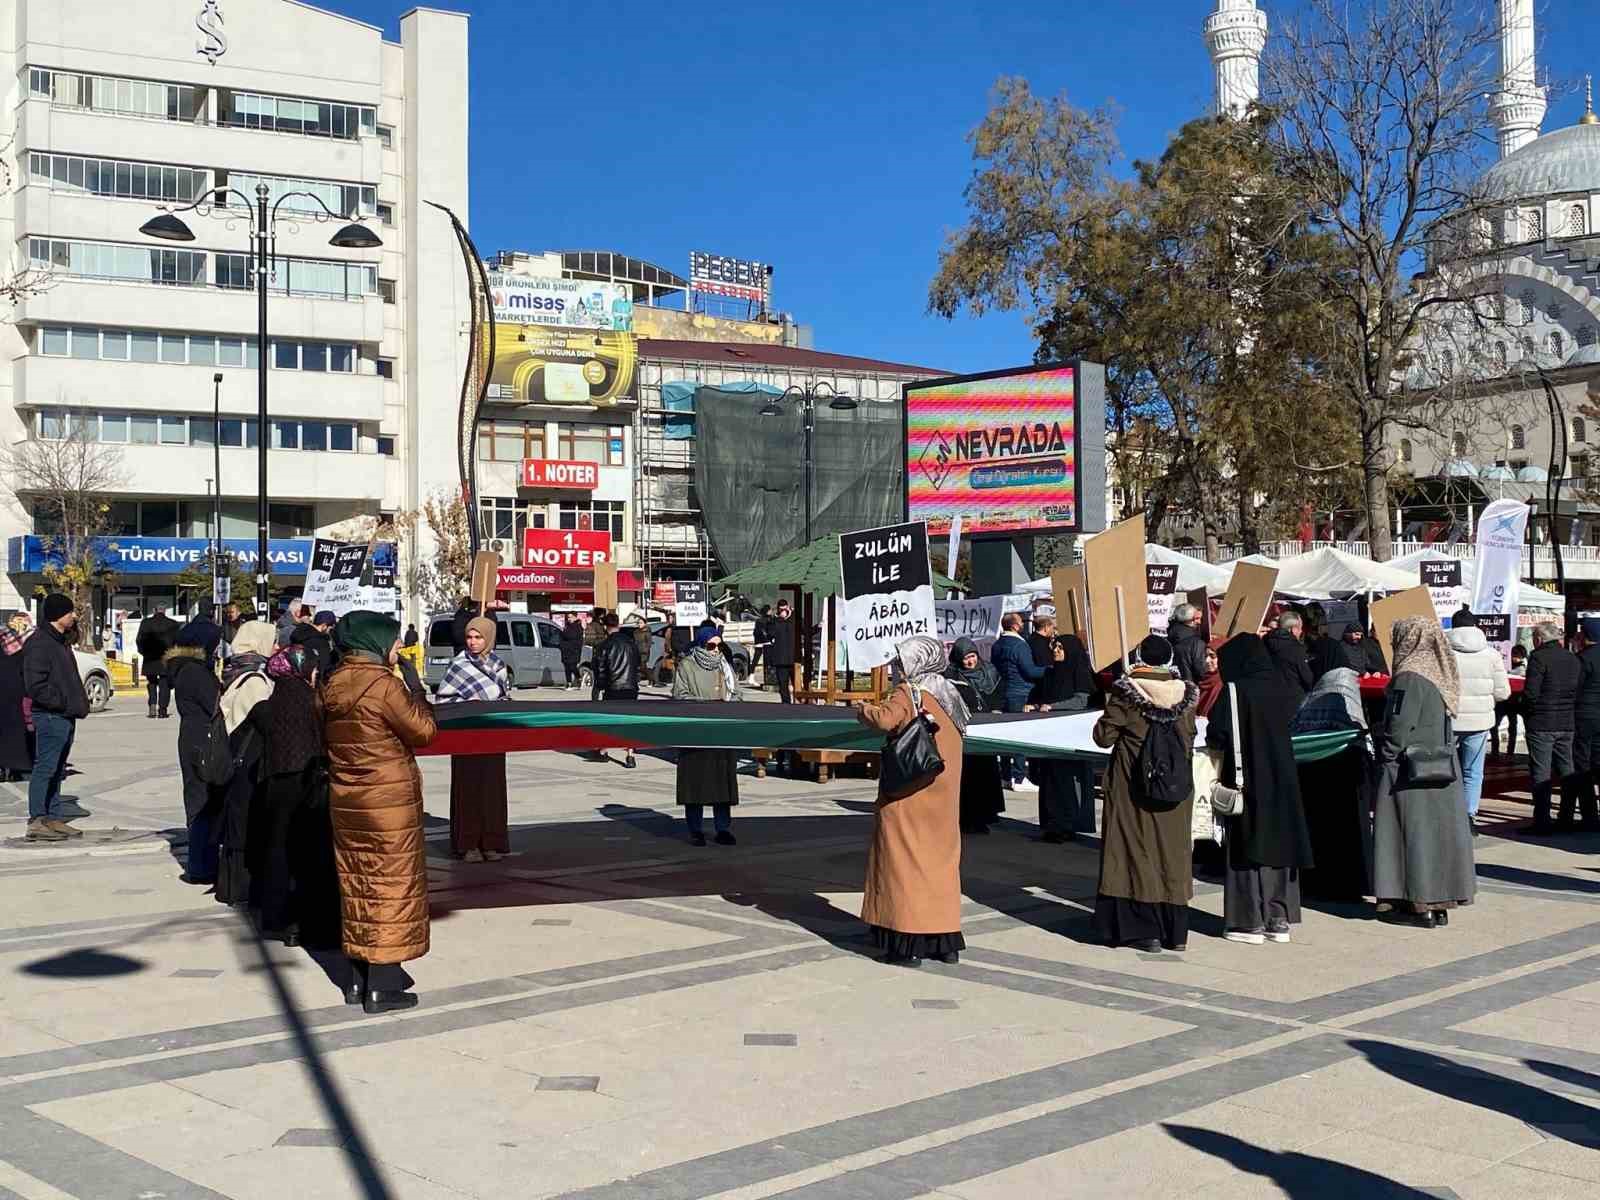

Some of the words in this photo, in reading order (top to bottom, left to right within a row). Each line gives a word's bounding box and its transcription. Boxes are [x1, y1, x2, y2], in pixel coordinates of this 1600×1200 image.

[695, 252, 763, 287] PEGEM
[509, 293, 565, 314] misaş
[495, 313, 561, 324] MARKETLERDE
[956, 422, 1066, 460] NEVRADA
[528, 464, 541, 481] 1.
[545, 464, 594, 483] NOTER
[319, 543, 336, 553] ZULÜ
[564, 533, 579, 548] 1.
[855, 532, 912, 559] ZULÜM
[118, 545, 200, 562] TÜRKİYE
[339, 548, 362, 560] ZULÜM
[528, 549, 606, 565] NOTER
[340, 562, 353, 574] İLE
[872, 562, 901, 585] İLE
[1149, 567, 1173, 578] ZULÜM
[1426, 562, 1455, 573] ZULÜM
[503, 573, 555, 584] vodafone
[1152, 579, 1166, 590] İLE
[1434, 574, 1449, 584] İLE
[961, 603, 992, 638] İÇİN
[1479, 615, 1505, 626] ZULÜM
[855, 617, 928, 641] OLUNMAZ!
